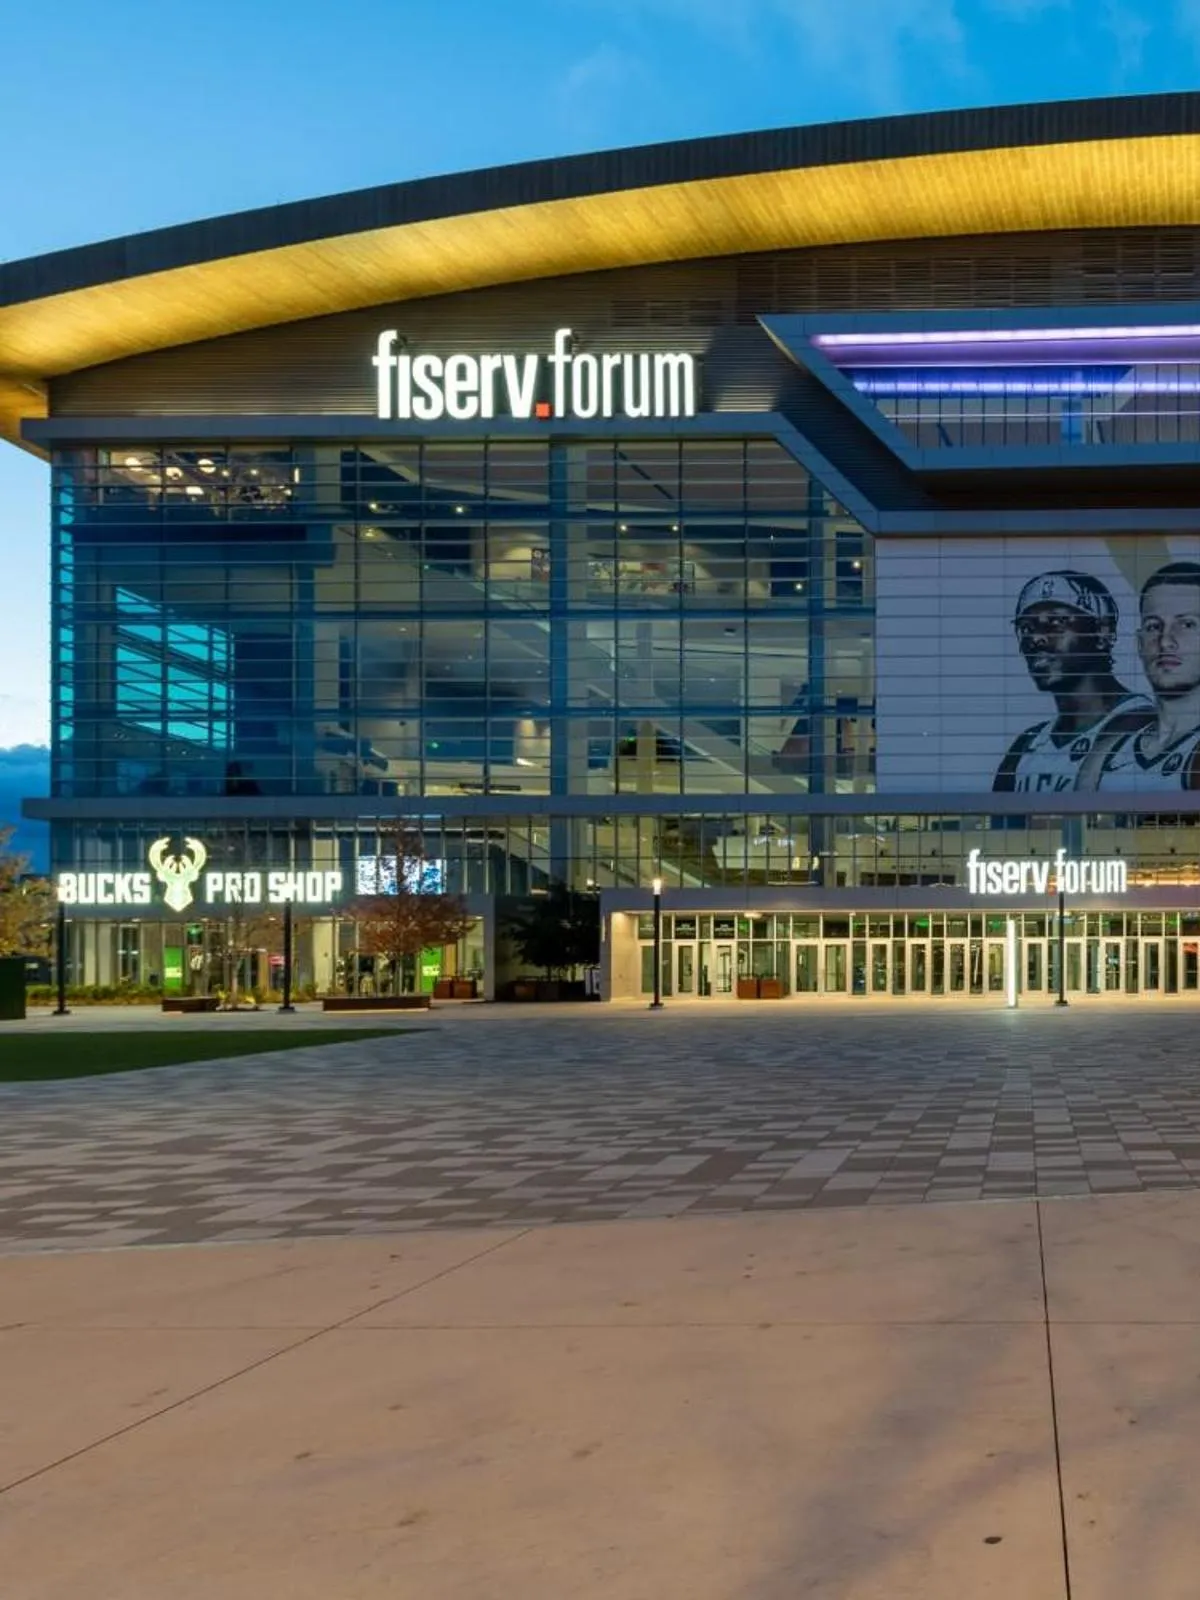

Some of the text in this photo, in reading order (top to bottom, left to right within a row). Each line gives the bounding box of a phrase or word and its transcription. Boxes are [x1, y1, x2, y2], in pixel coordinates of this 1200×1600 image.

[58, 871, 343, 904] BUCKS PRO SHOP
